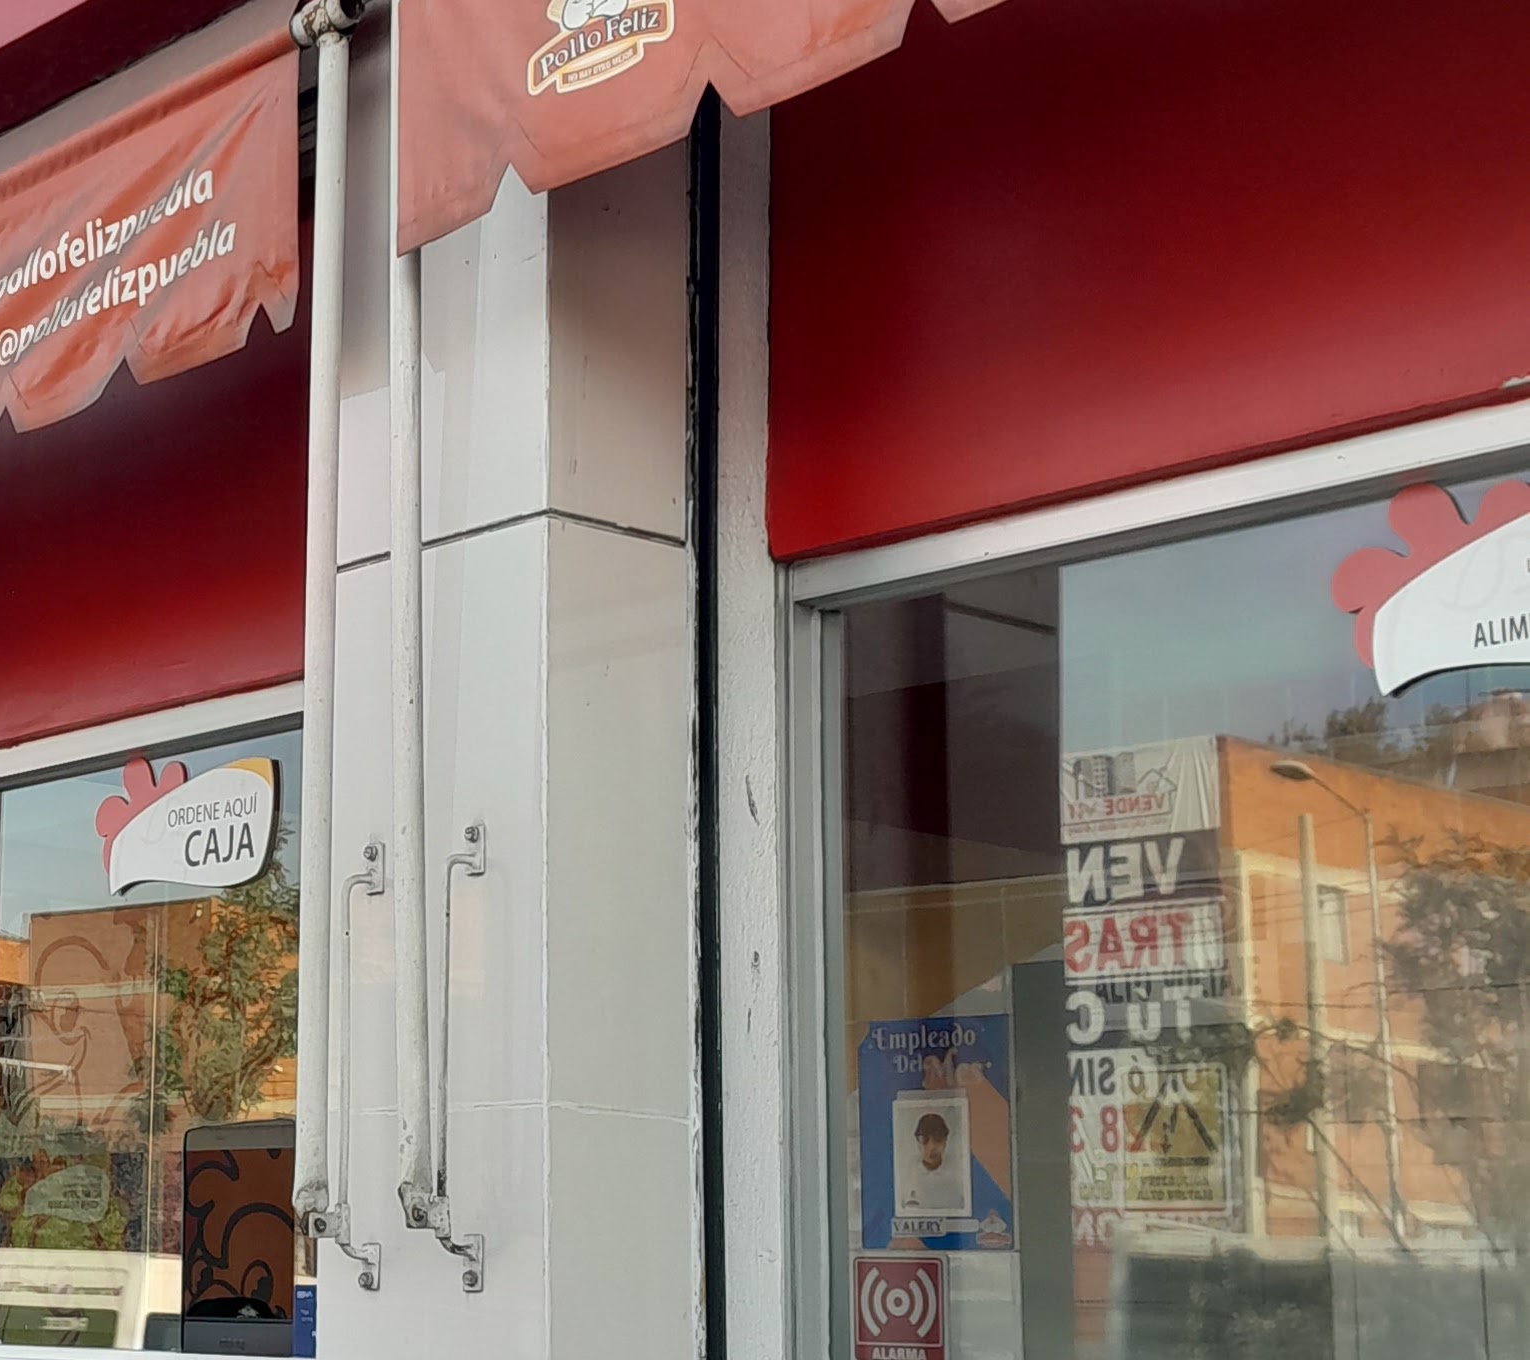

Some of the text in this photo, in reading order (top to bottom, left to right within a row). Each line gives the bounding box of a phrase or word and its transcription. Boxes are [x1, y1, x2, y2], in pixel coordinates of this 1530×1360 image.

[539, 6, 661, 80] Pollo Feliz
[168, 801, 221, 829] ORDENE
[184, 822, 256, 868] CAJA
[872, 1023, 977, 1055] Empleado
